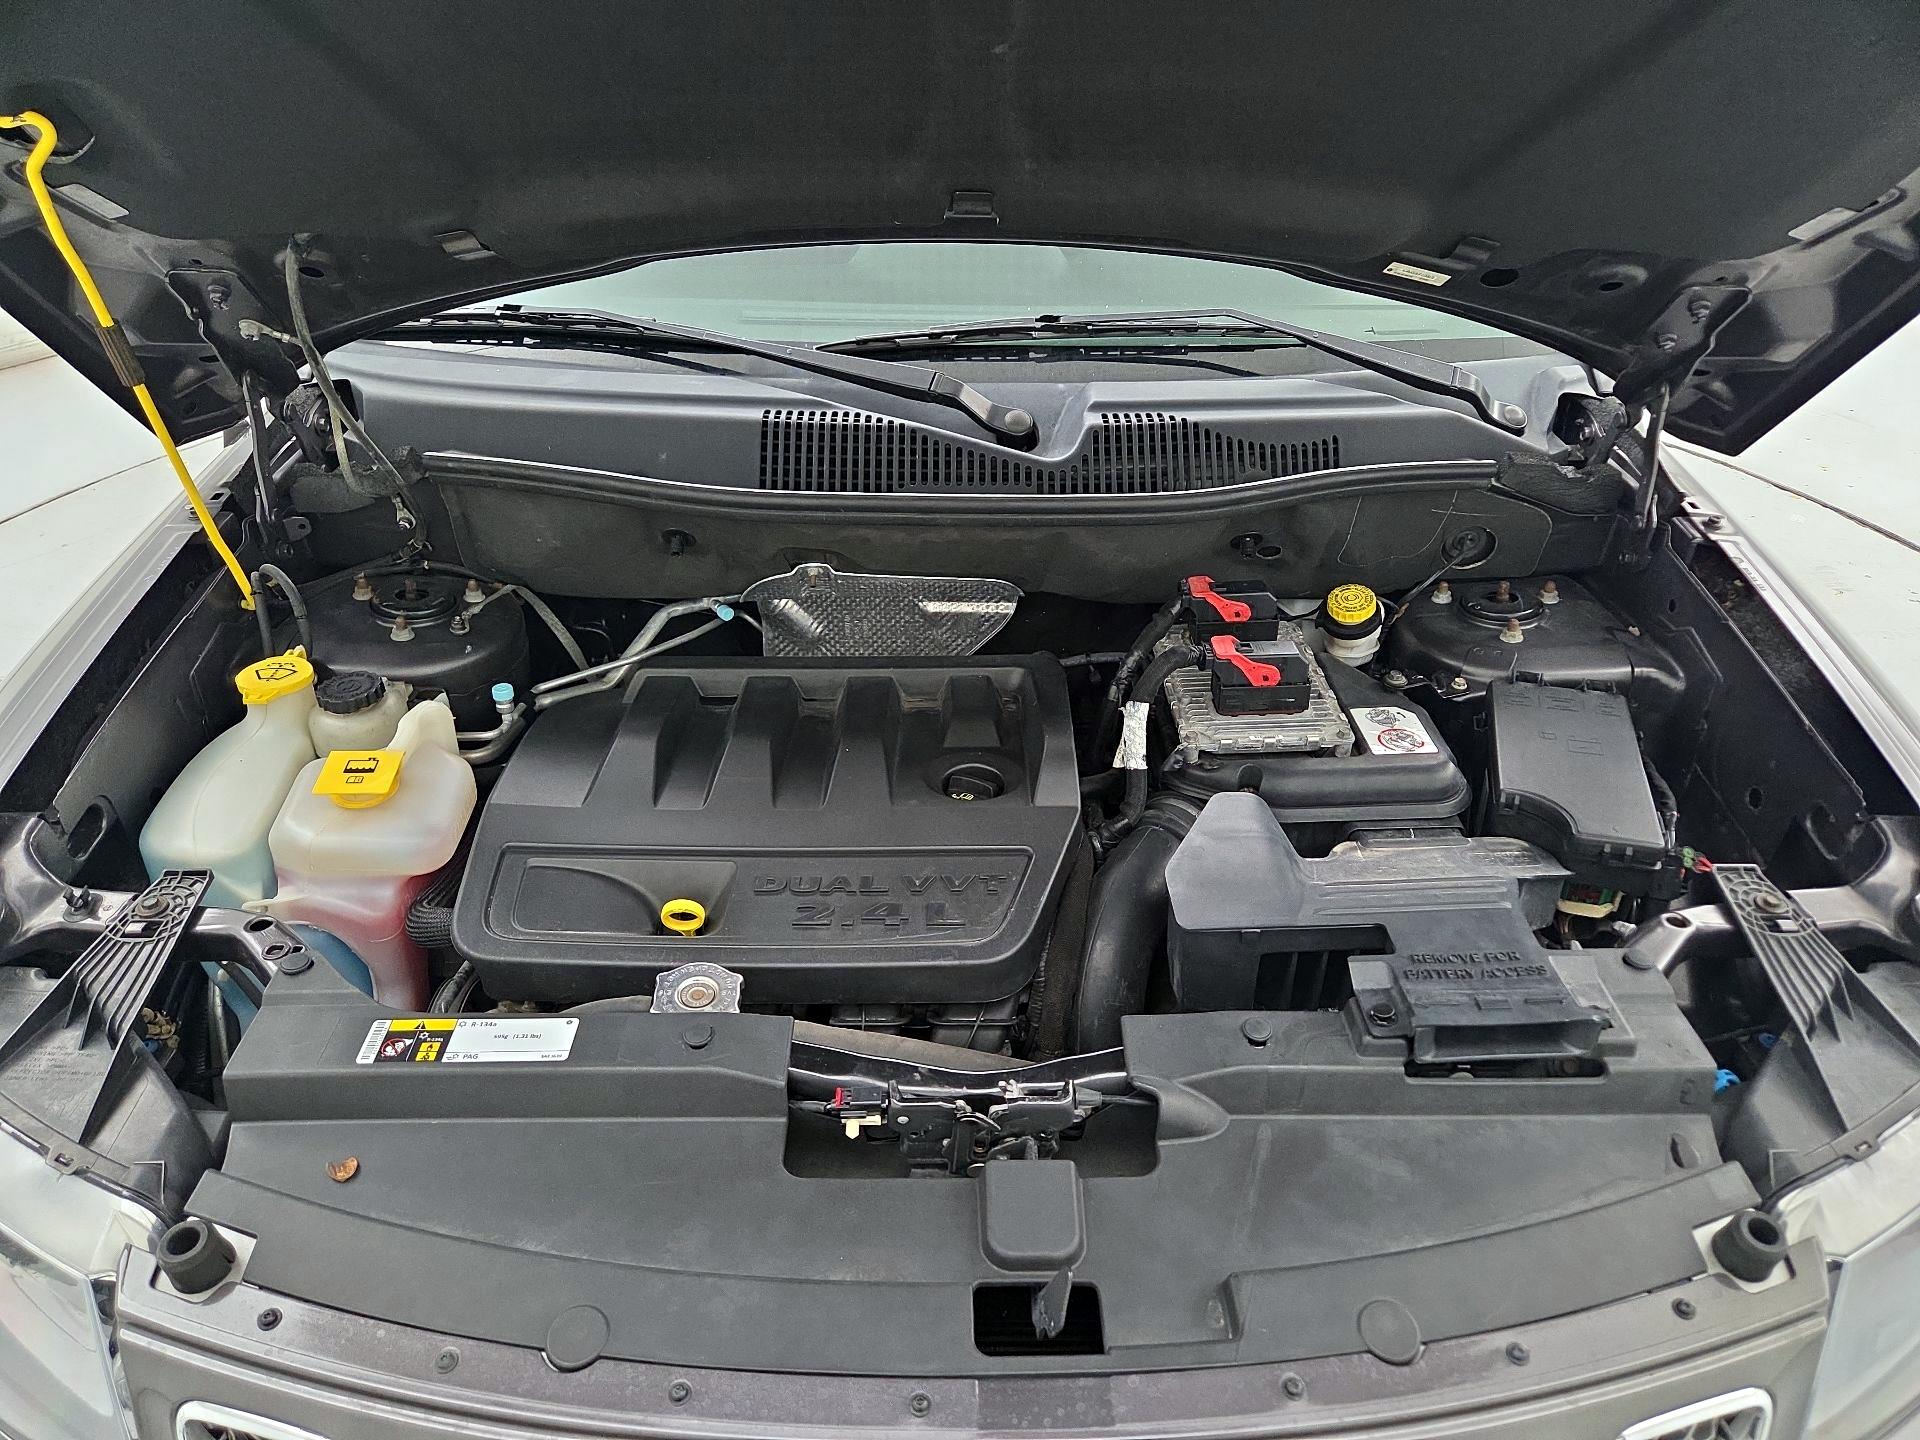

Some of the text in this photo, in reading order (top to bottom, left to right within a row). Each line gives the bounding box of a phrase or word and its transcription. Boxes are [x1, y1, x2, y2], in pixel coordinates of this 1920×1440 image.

[753, 874, 1008, 896] DUAL VVT
[792, 902, 966, 928] 2.4 L
[1409, 951, 1521, 965] REMOVE FOR
[1403, 965, 1548, 981] BATTERY ACCESS
